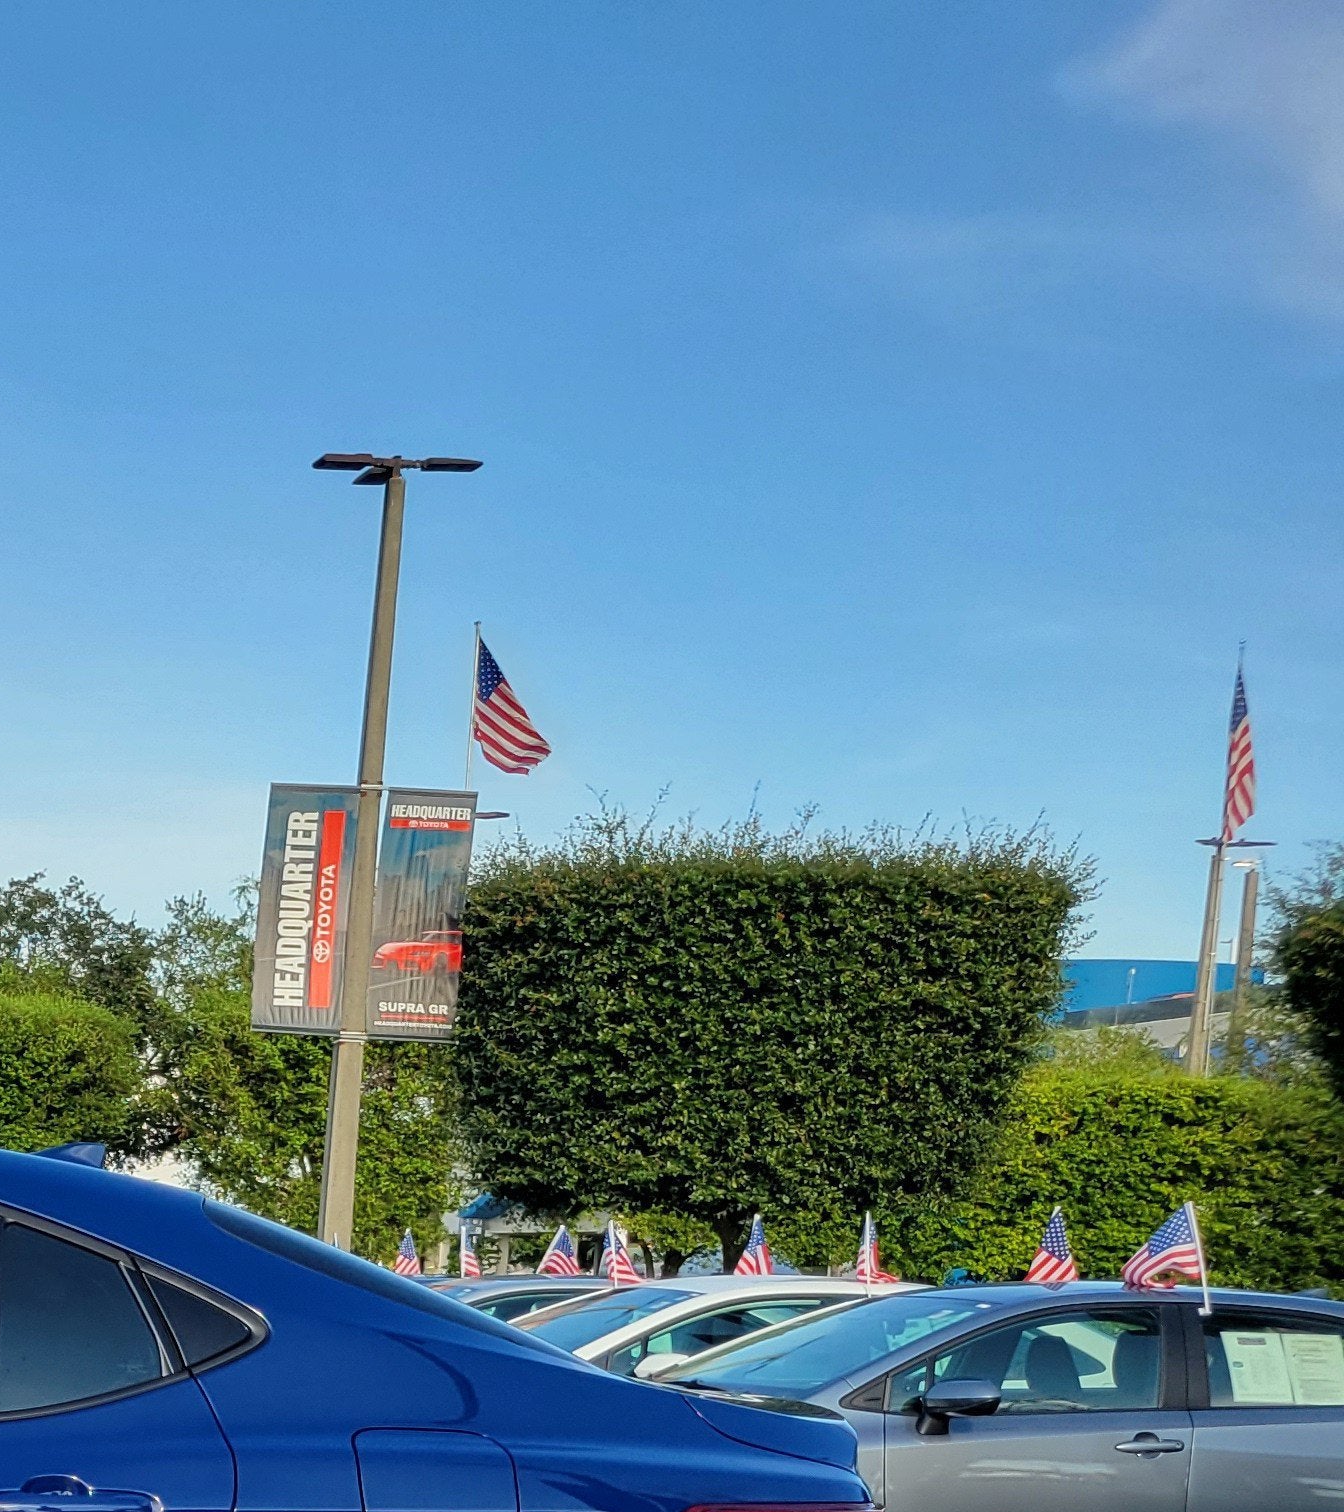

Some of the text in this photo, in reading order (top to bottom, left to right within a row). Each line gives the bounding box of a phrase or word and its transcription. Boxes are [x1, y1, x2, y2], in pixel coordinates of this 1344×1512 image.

[390, 804, 472, 821] HEADQUARTER
[418, 820, 449, 829] TOYOTA
[273, 811, 319, 1007] HEADQUARTER
[315, 864, 337, 939] TOYOTA
[378, 1001, 449, 1015] SUPRA GR
